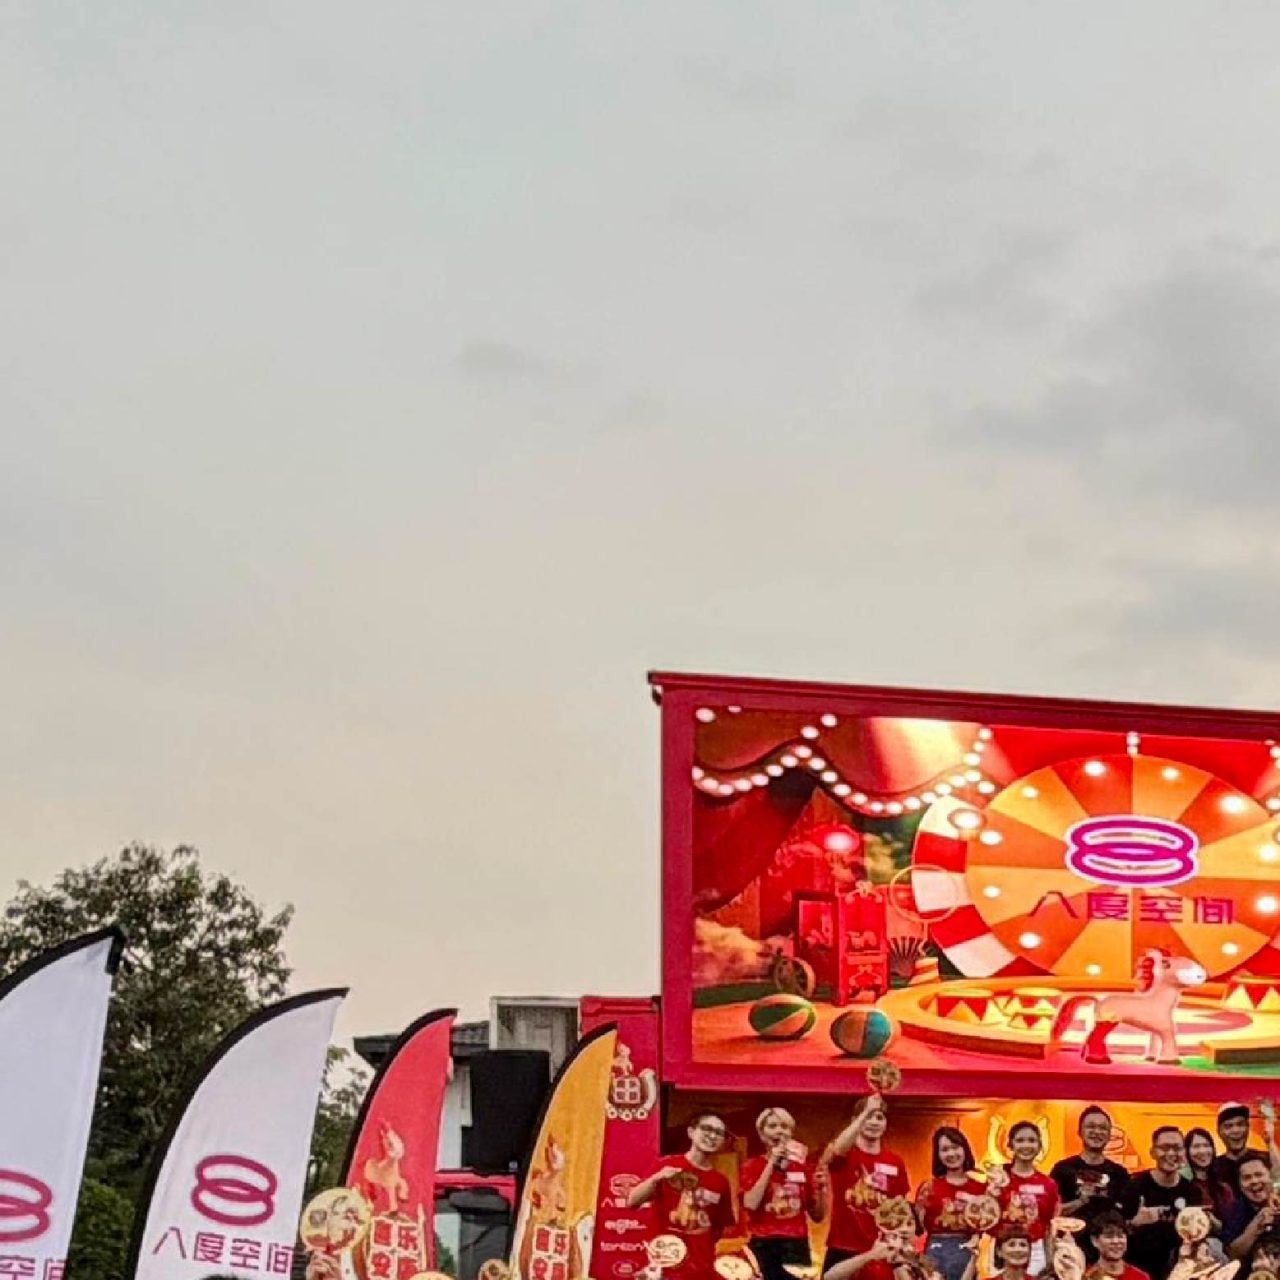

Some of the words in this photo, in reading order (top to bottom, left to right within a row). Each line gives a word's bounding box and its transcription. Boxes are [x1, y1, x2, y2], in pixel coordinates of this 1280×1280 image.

[1027, 890, 1234, 925] 八度空间
[153, 1225, 293, 1275] 八度空间
